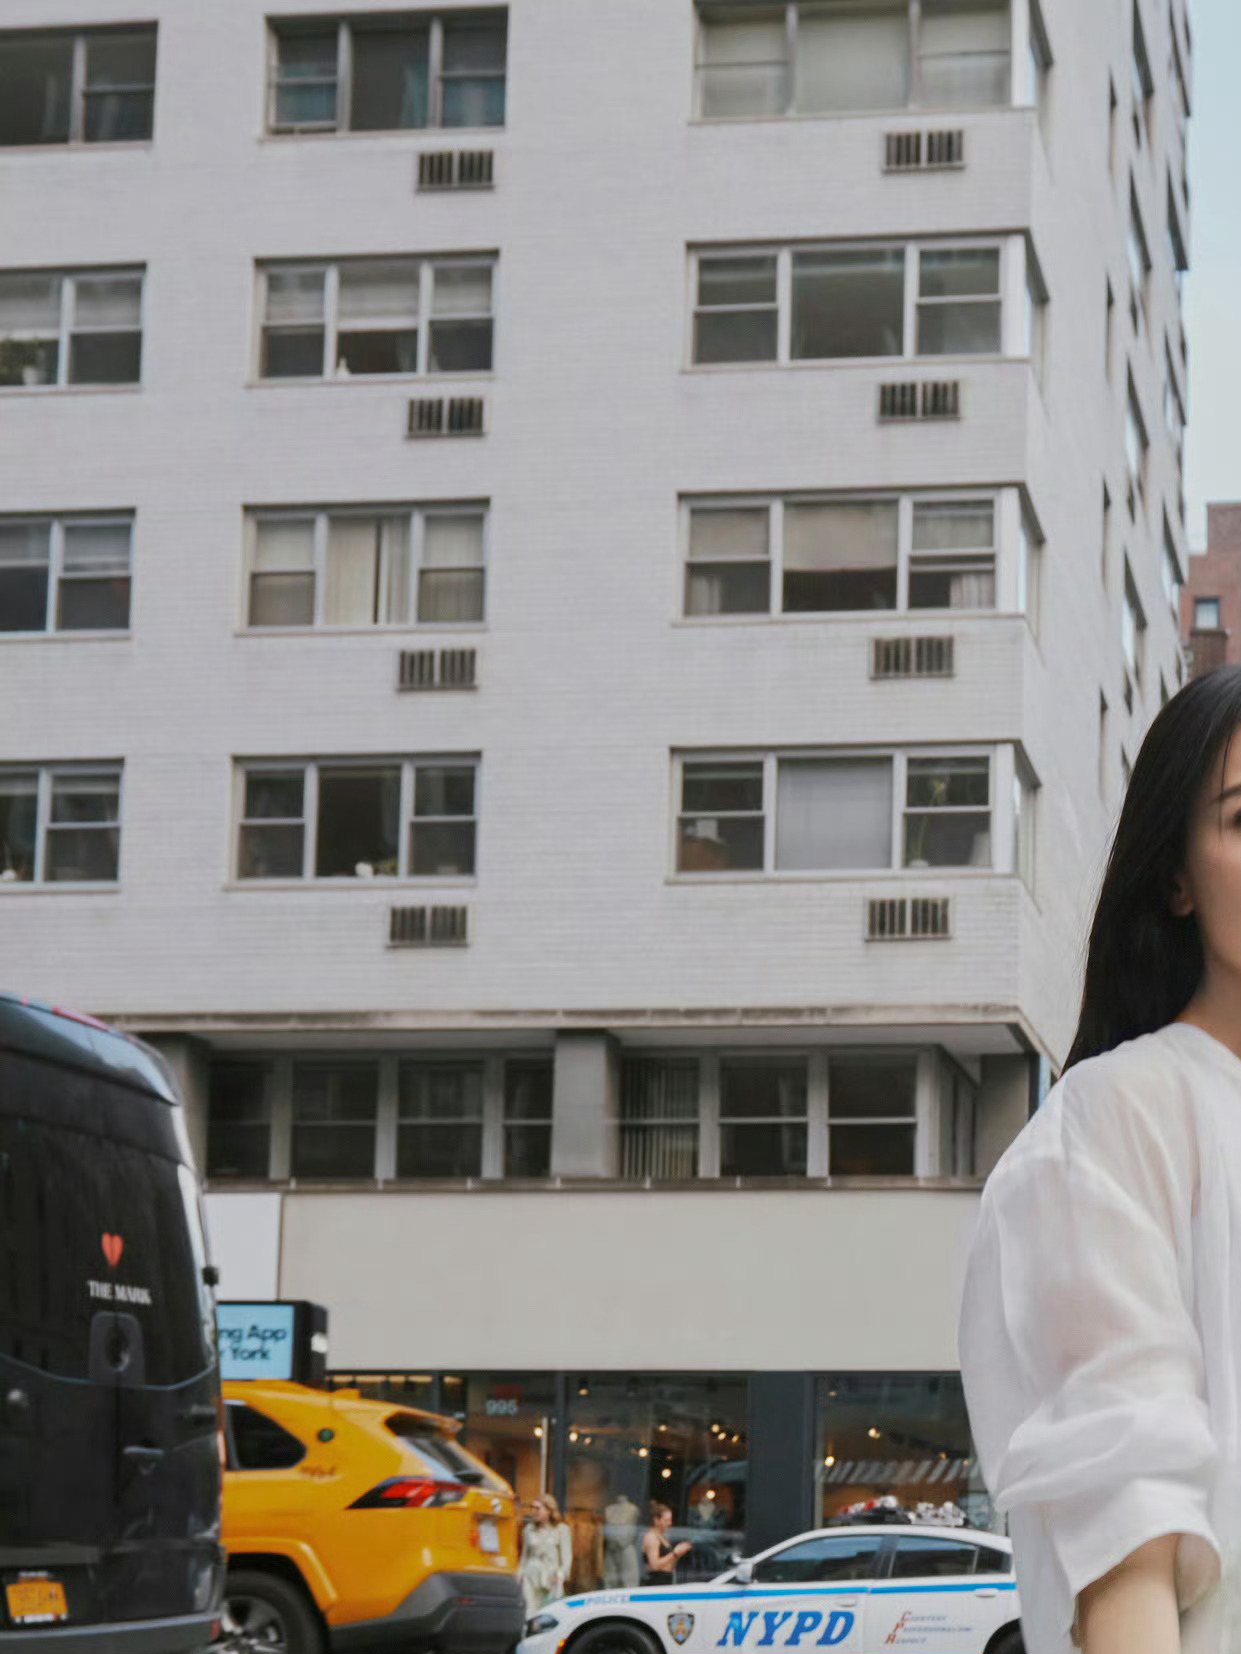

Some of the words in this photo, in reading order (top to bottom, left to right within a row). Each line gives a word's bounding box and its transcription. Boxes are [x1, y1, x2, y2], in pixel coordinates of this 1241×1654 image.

[87, 1280, 112, 1300] THE
[217, 1328, 243, 1346] ng
[247, 1324, 288, 1346] App
[231, 1347, 271, 1361] York
[716, 1611, 855, 1646] NYPD
